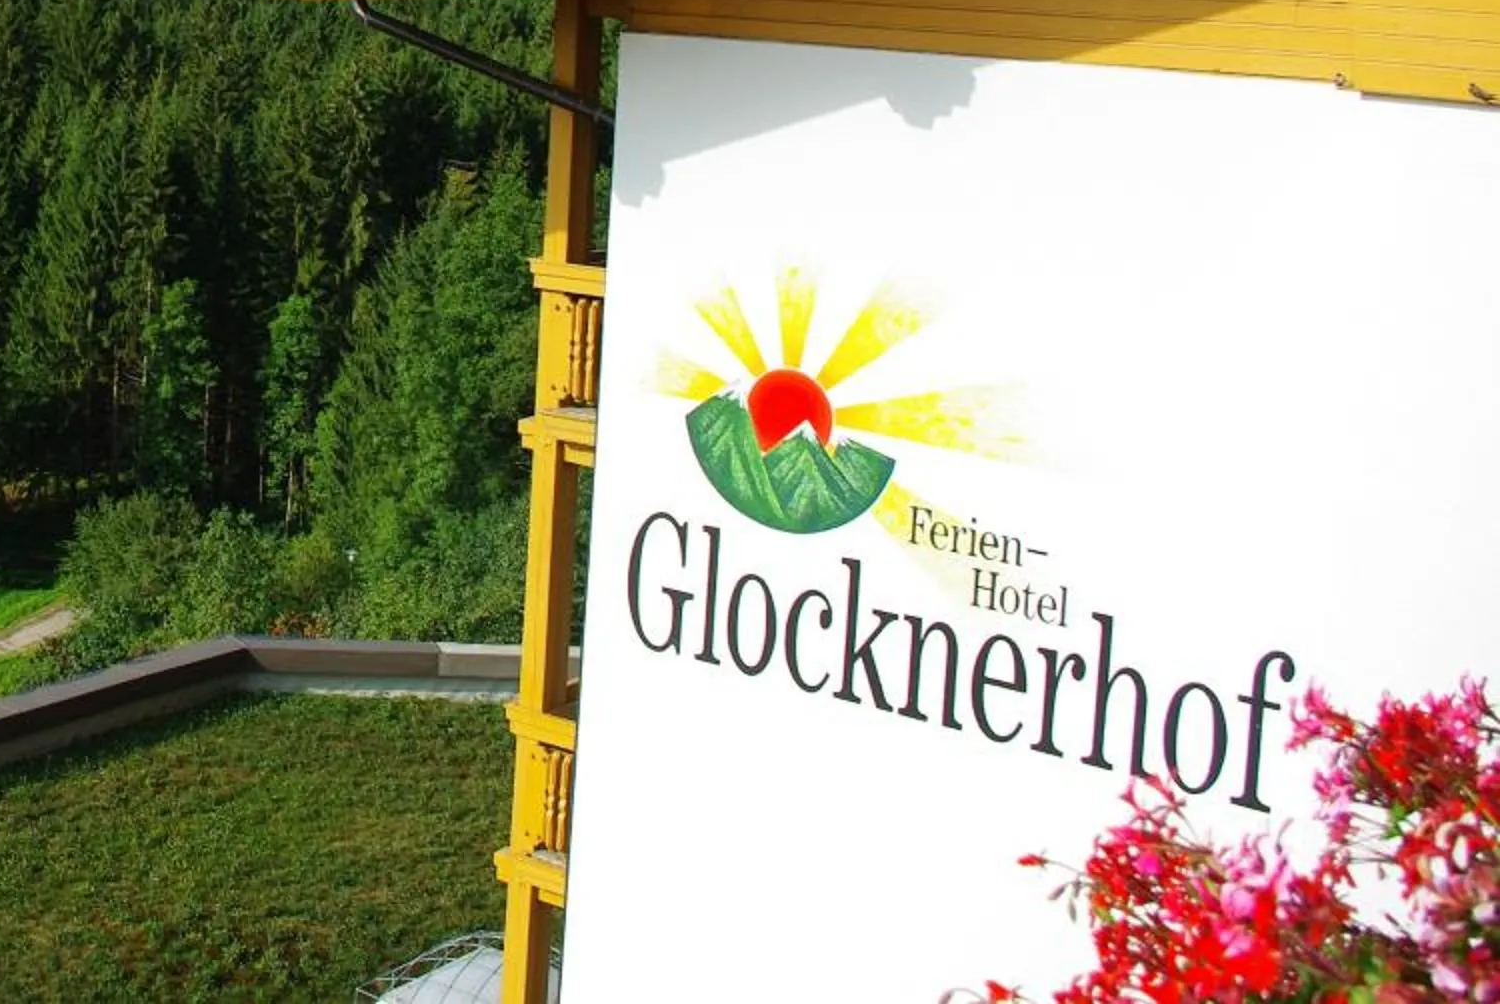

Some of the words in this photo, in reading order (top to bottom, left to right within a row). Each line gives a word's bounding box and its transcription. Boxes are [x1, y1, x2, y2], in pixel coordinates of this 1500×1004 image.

[908, 505, 1050, 567] Ferien-
[970, 567, 1068, 628] Hotel
[626, 510, 1297, 815] Glocknerhof
